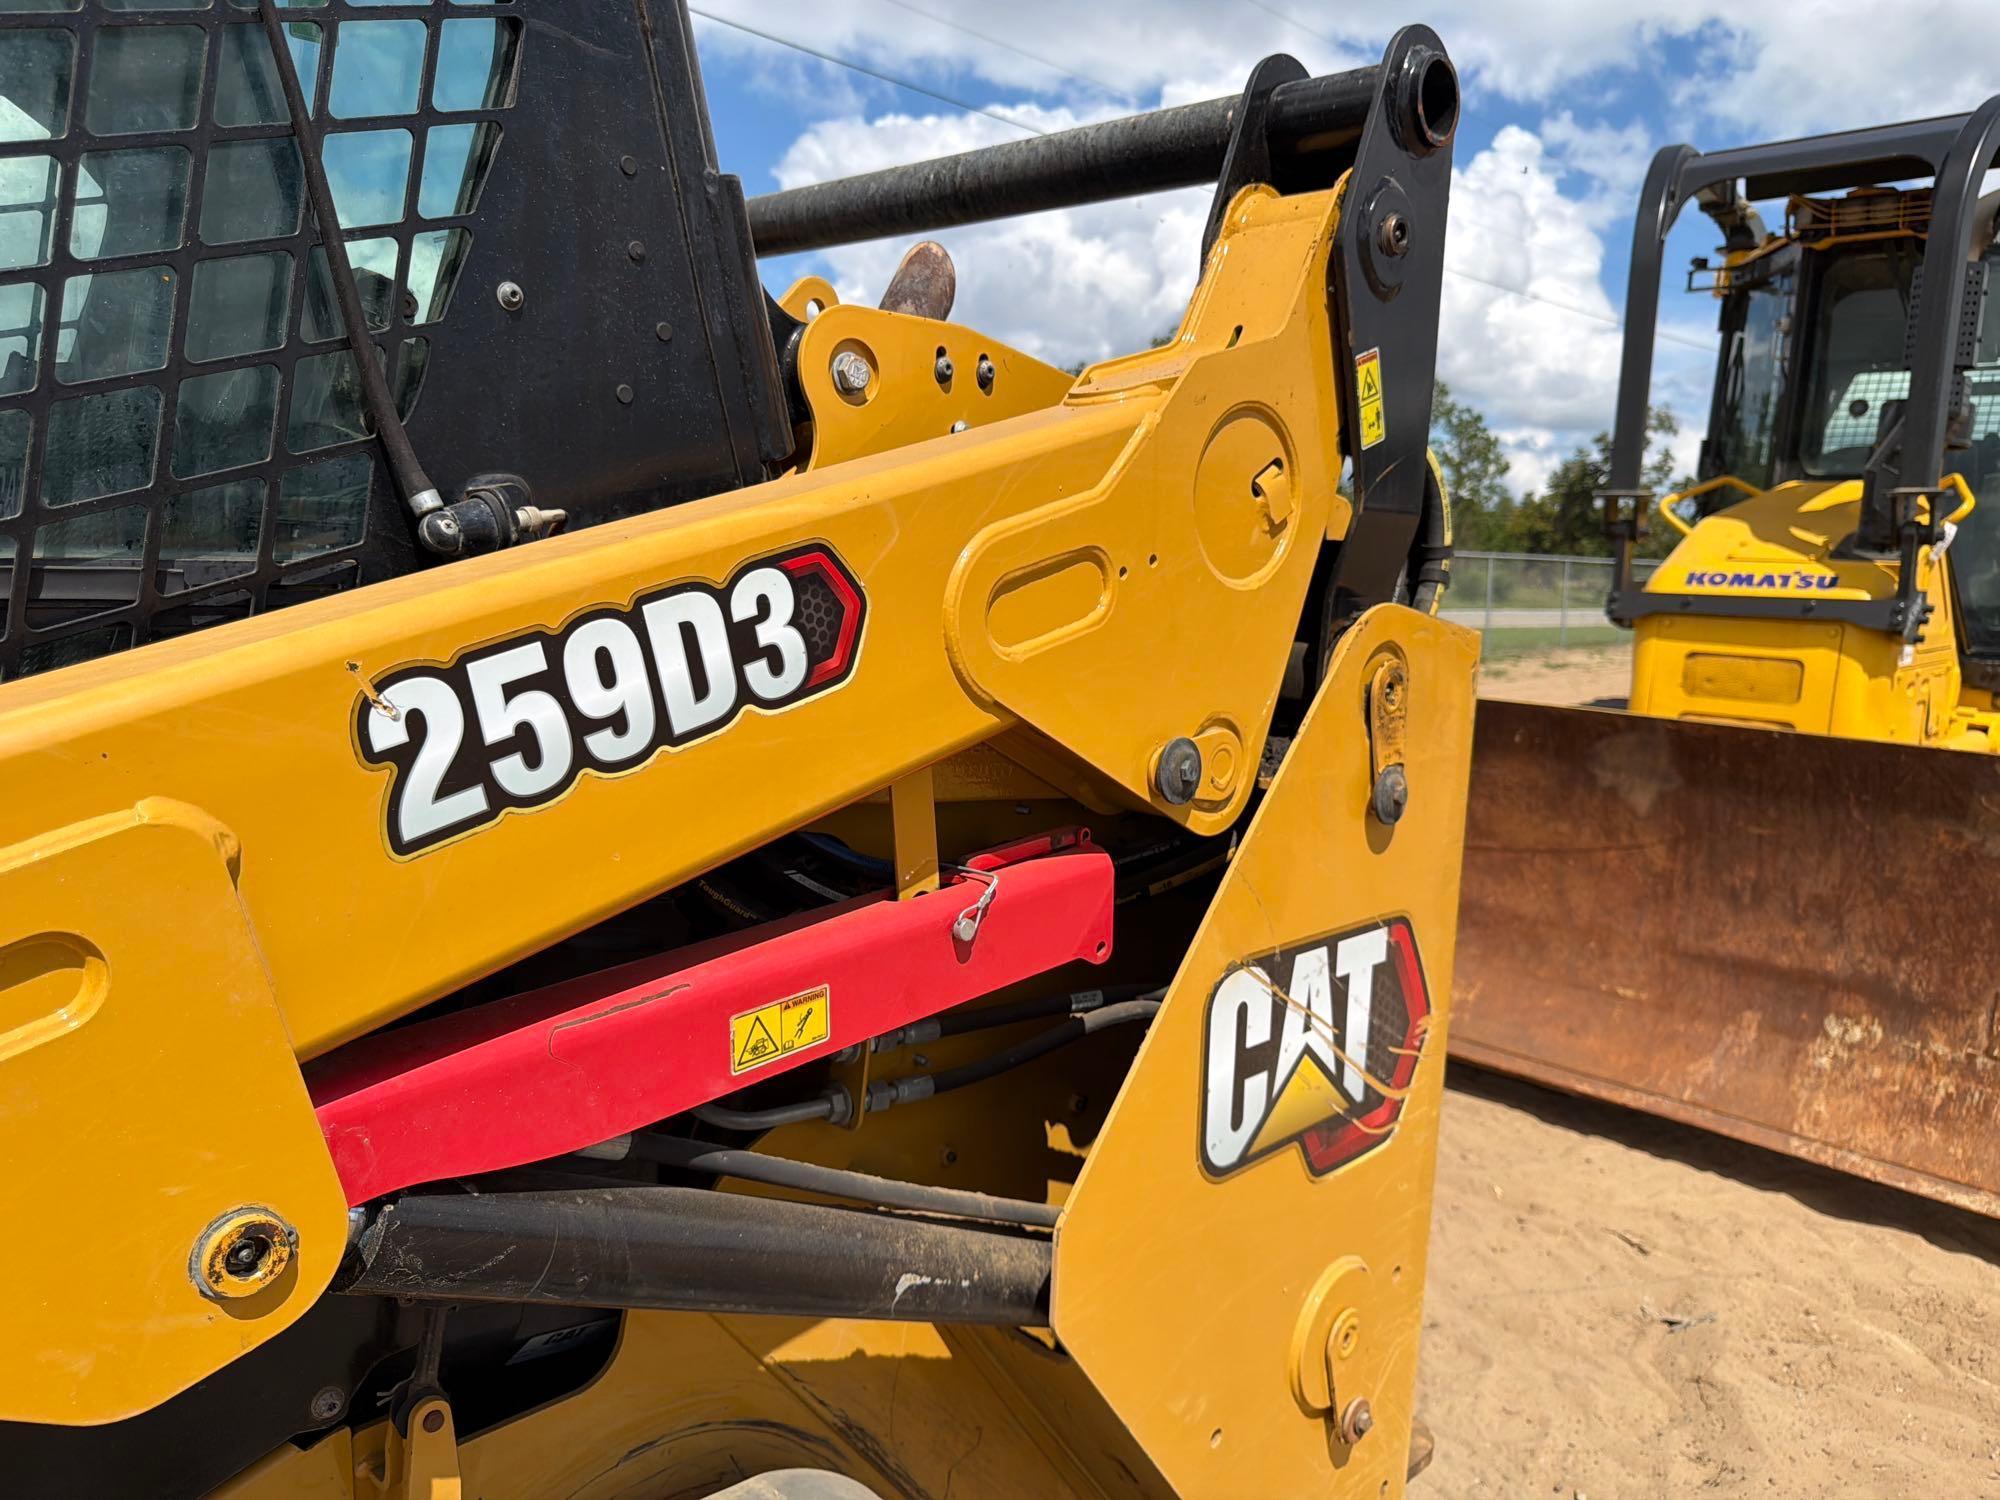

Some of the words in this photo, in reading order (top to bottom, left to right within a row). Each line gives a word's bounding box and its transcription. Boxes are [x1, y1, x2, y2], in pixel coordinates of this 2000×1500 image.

[1685, 570, 1840, 590] KOMATSU
[367, 566, 809, 845] 259D3
[791, 991, 825, 1007] WARNING
[1205, 926, 1389, 1168] CAT
